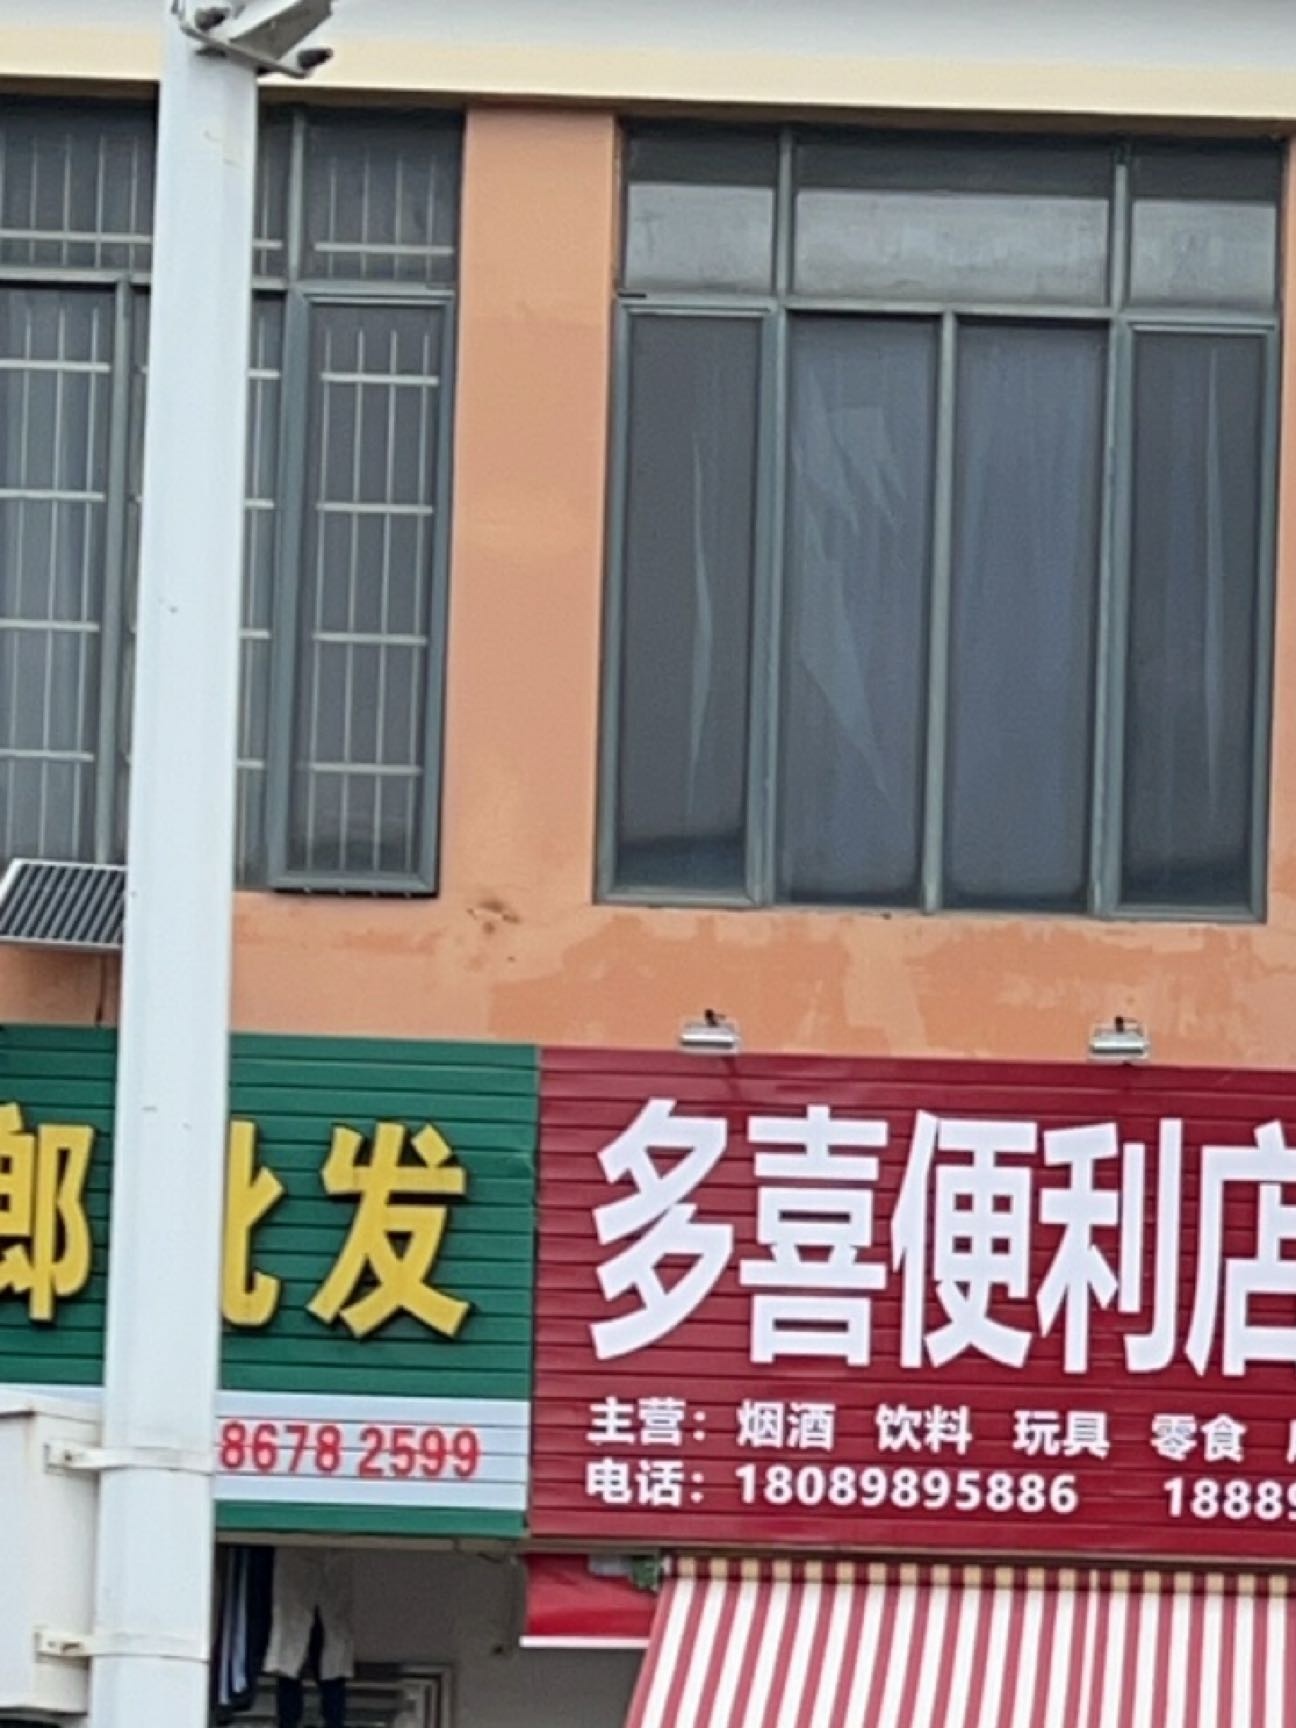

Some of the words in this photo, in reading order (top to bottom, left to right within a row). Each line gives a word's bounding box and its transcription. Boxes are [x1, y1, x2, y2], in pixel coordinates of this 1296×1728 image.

[220, 1420, 342, 1475] 8678
[356, 1426, 479, 1480] 2599
[587, 1397, 706, 1446] 主营：
[736, 1400, 835, 1450] 烟酒
[876, 1404, 972, 1455] 饮料
[1013, 1409, 1109, 1459] 玩具
[1150, 1413, 1247, 1462] 零食
[586, 1458, 704, 1507] 电话：
[735, 1464, 1079, 1514] 18089895886
